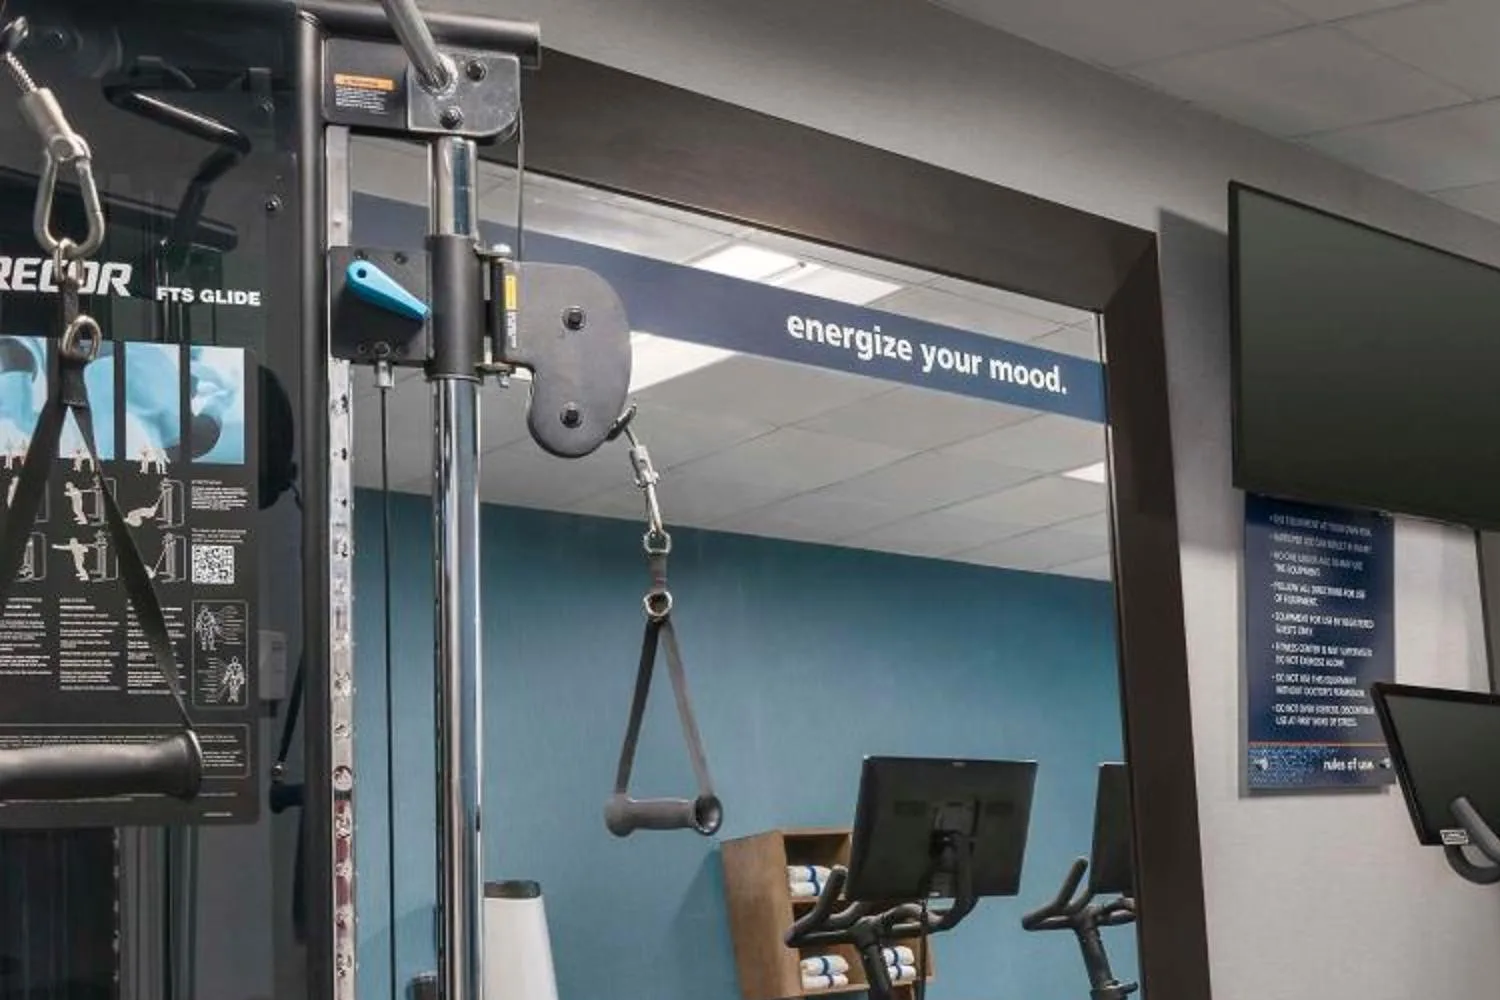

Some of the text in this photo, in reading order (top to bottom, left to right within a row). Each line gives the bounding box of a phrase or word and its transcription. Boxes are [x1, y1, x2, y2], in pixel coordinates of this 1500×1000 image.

[155, 286, 261, 307] FTS GLIDE
[786, 313, 1068, 395] energize your mood.
[1323, 757, 1345, 771] rules
[1347, 757, 1357, 771] of
